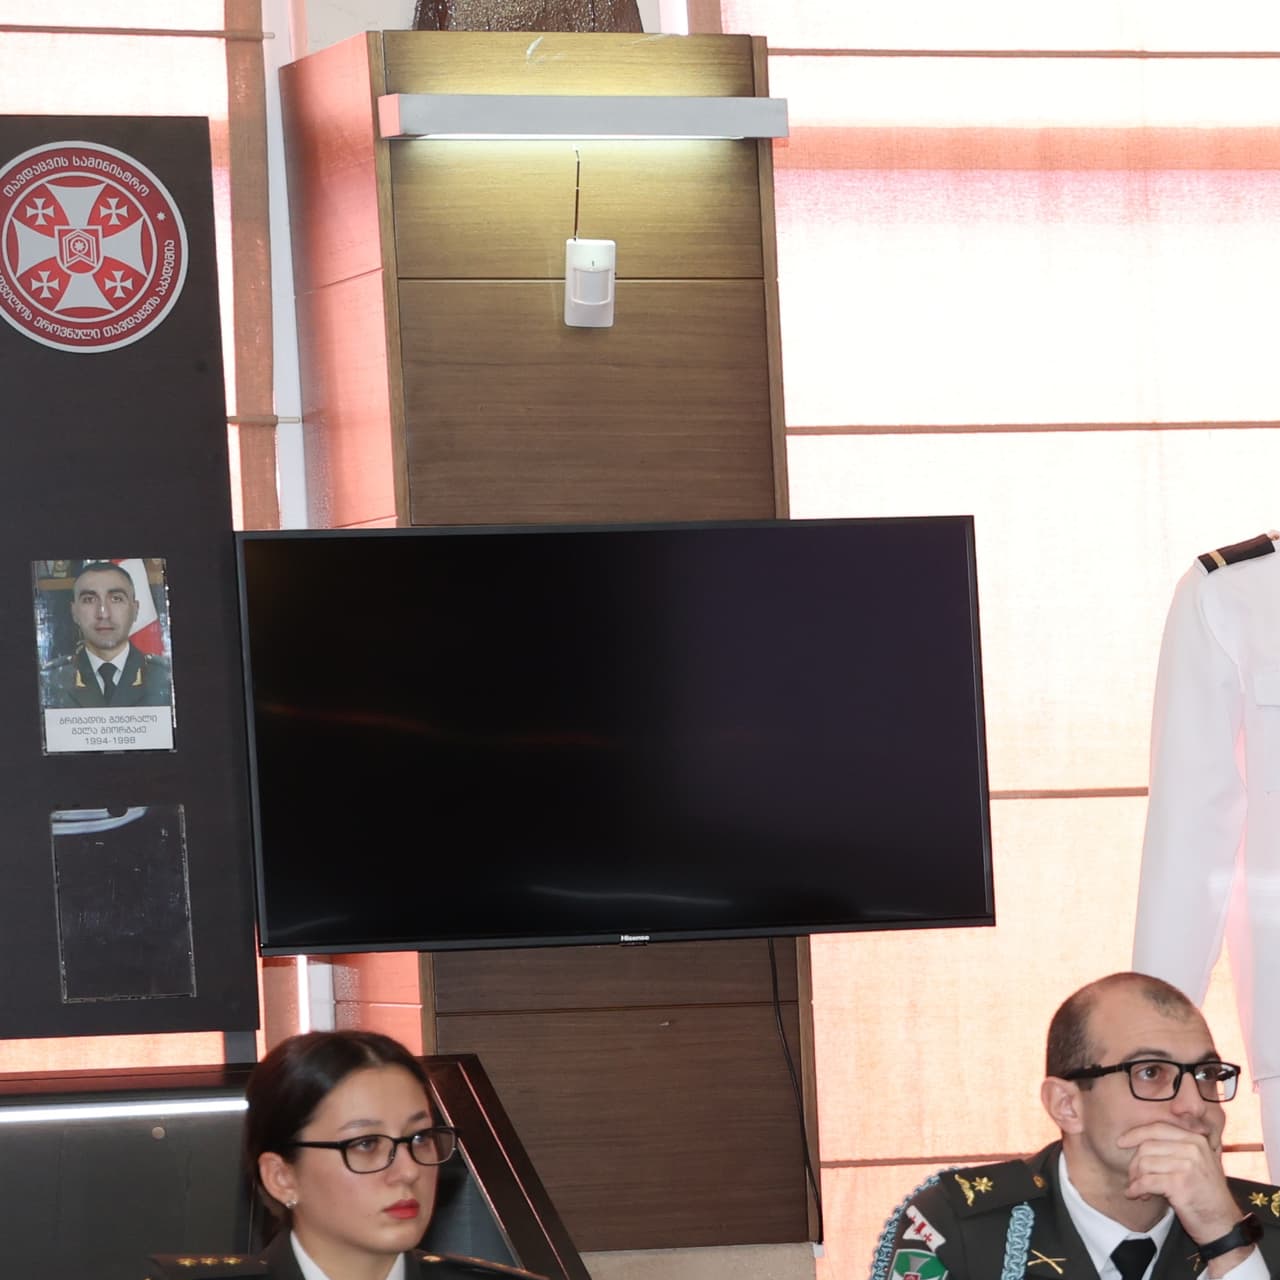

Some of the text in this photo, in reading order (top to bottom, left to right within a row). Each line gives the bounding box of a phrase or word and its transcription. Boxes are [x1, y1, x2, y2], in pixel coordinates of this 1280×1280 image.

[3, 155, 150, 197] თავდაცვის სამინისტრო
[34, 317, 101, 340] ეროვნული
[104, 297, 161, 338] თავდაცვის
[158, 239, 176, 296] აკადემია
